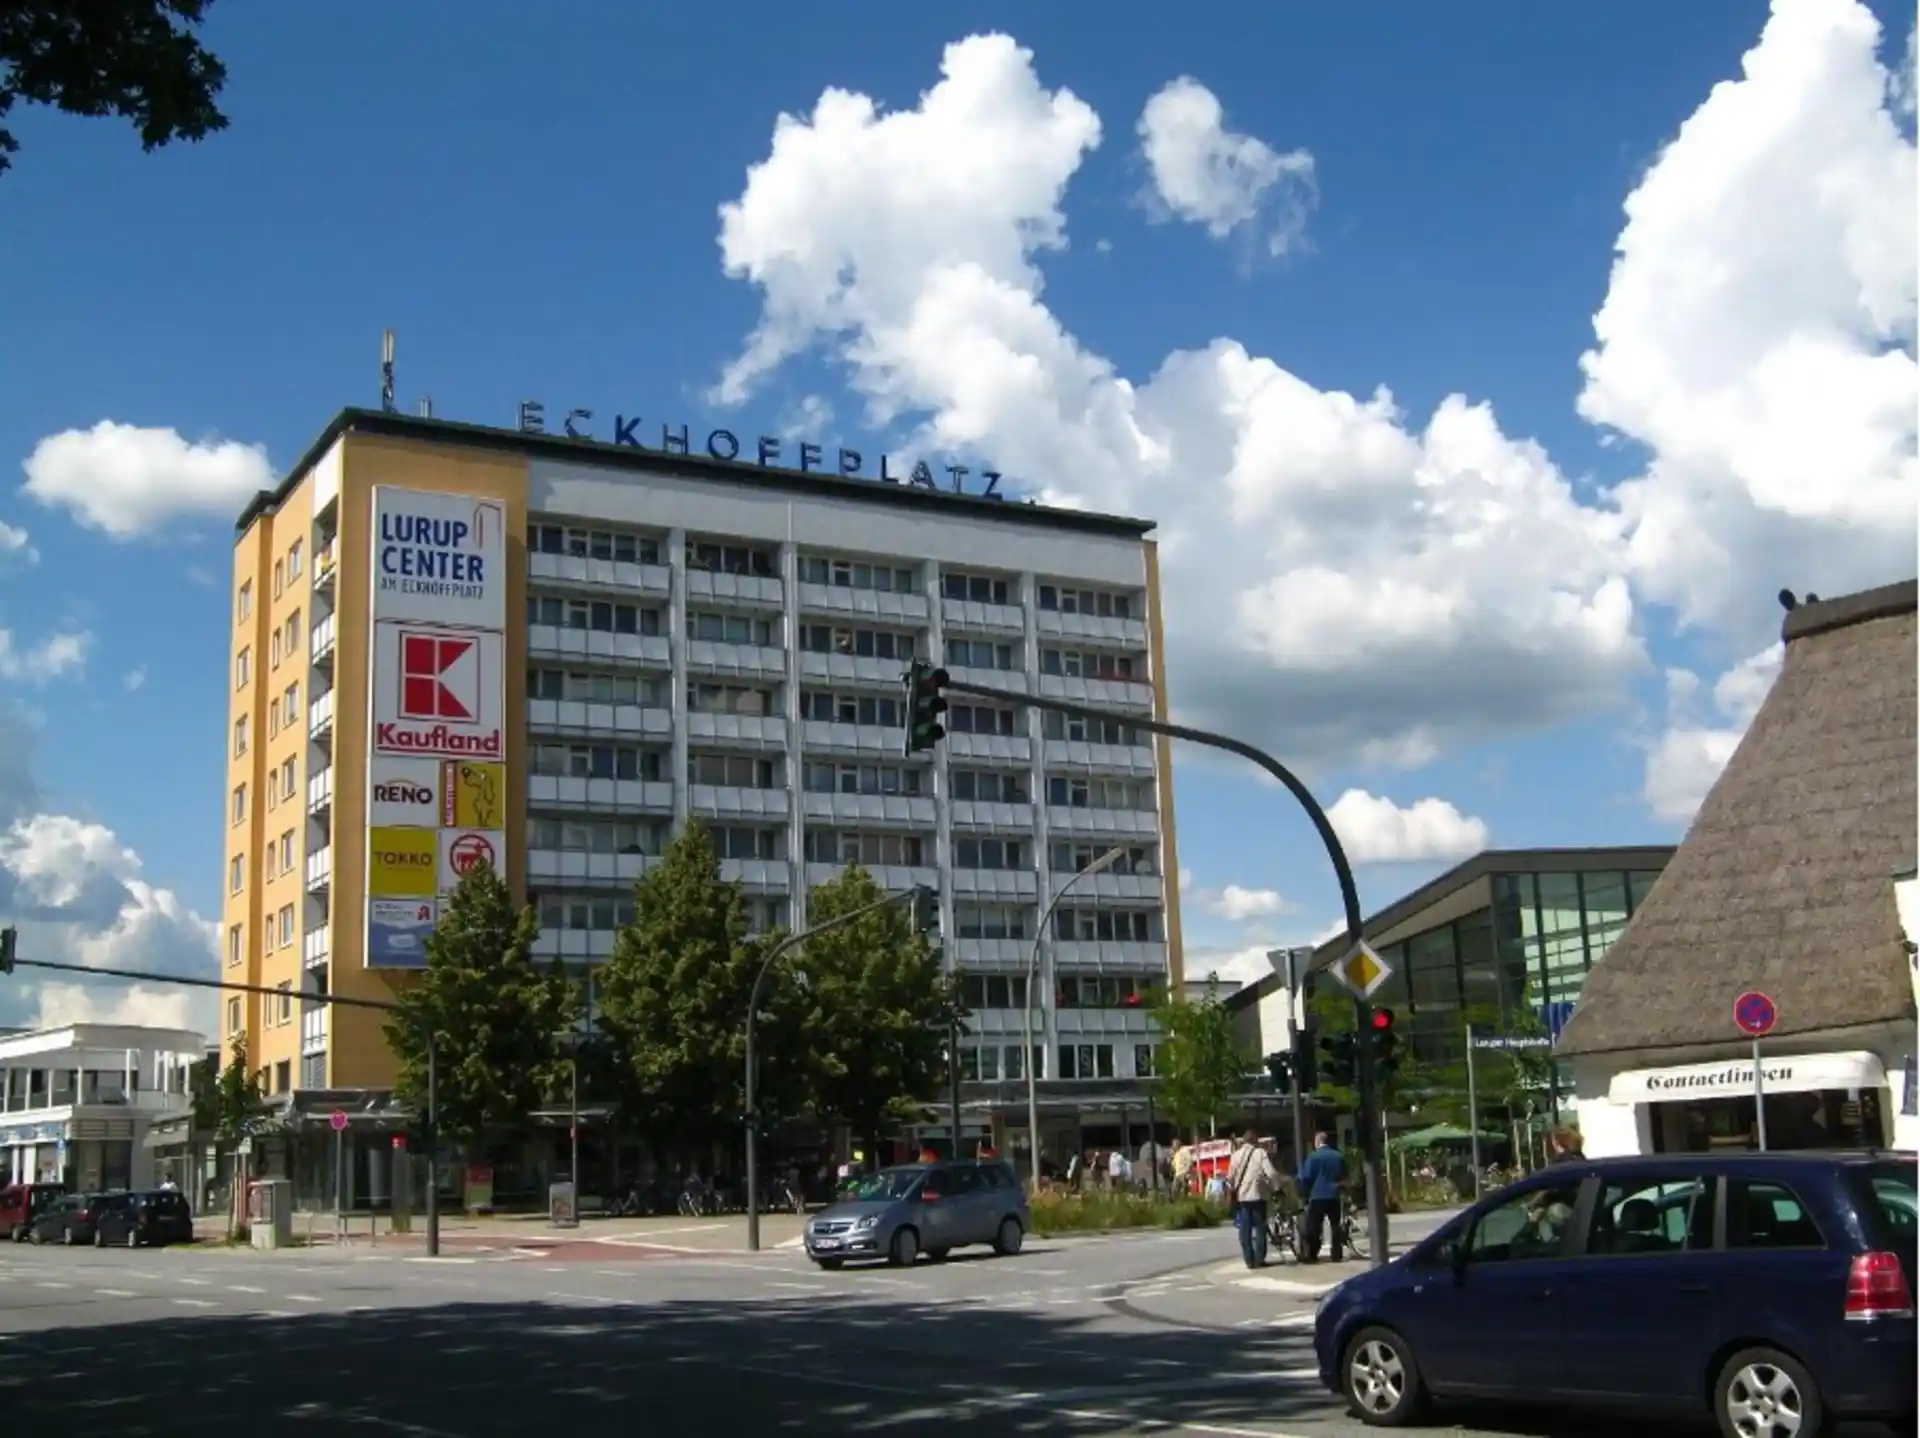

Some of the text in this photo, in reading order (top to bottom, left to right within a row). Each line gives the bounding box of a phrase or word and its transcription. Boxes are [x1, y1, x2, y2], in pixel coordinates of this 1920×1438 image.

[517, 400, 1003, 499] ECKHOFFPLATZ
[382, 512, 468, 548] LURUP
[381, 546, 483, 583] CENTER
[377, 722, 500, 752] Kaufland
[374, 785, 433, 804] RENO
[374, 851, 433, 867] TOKKO
